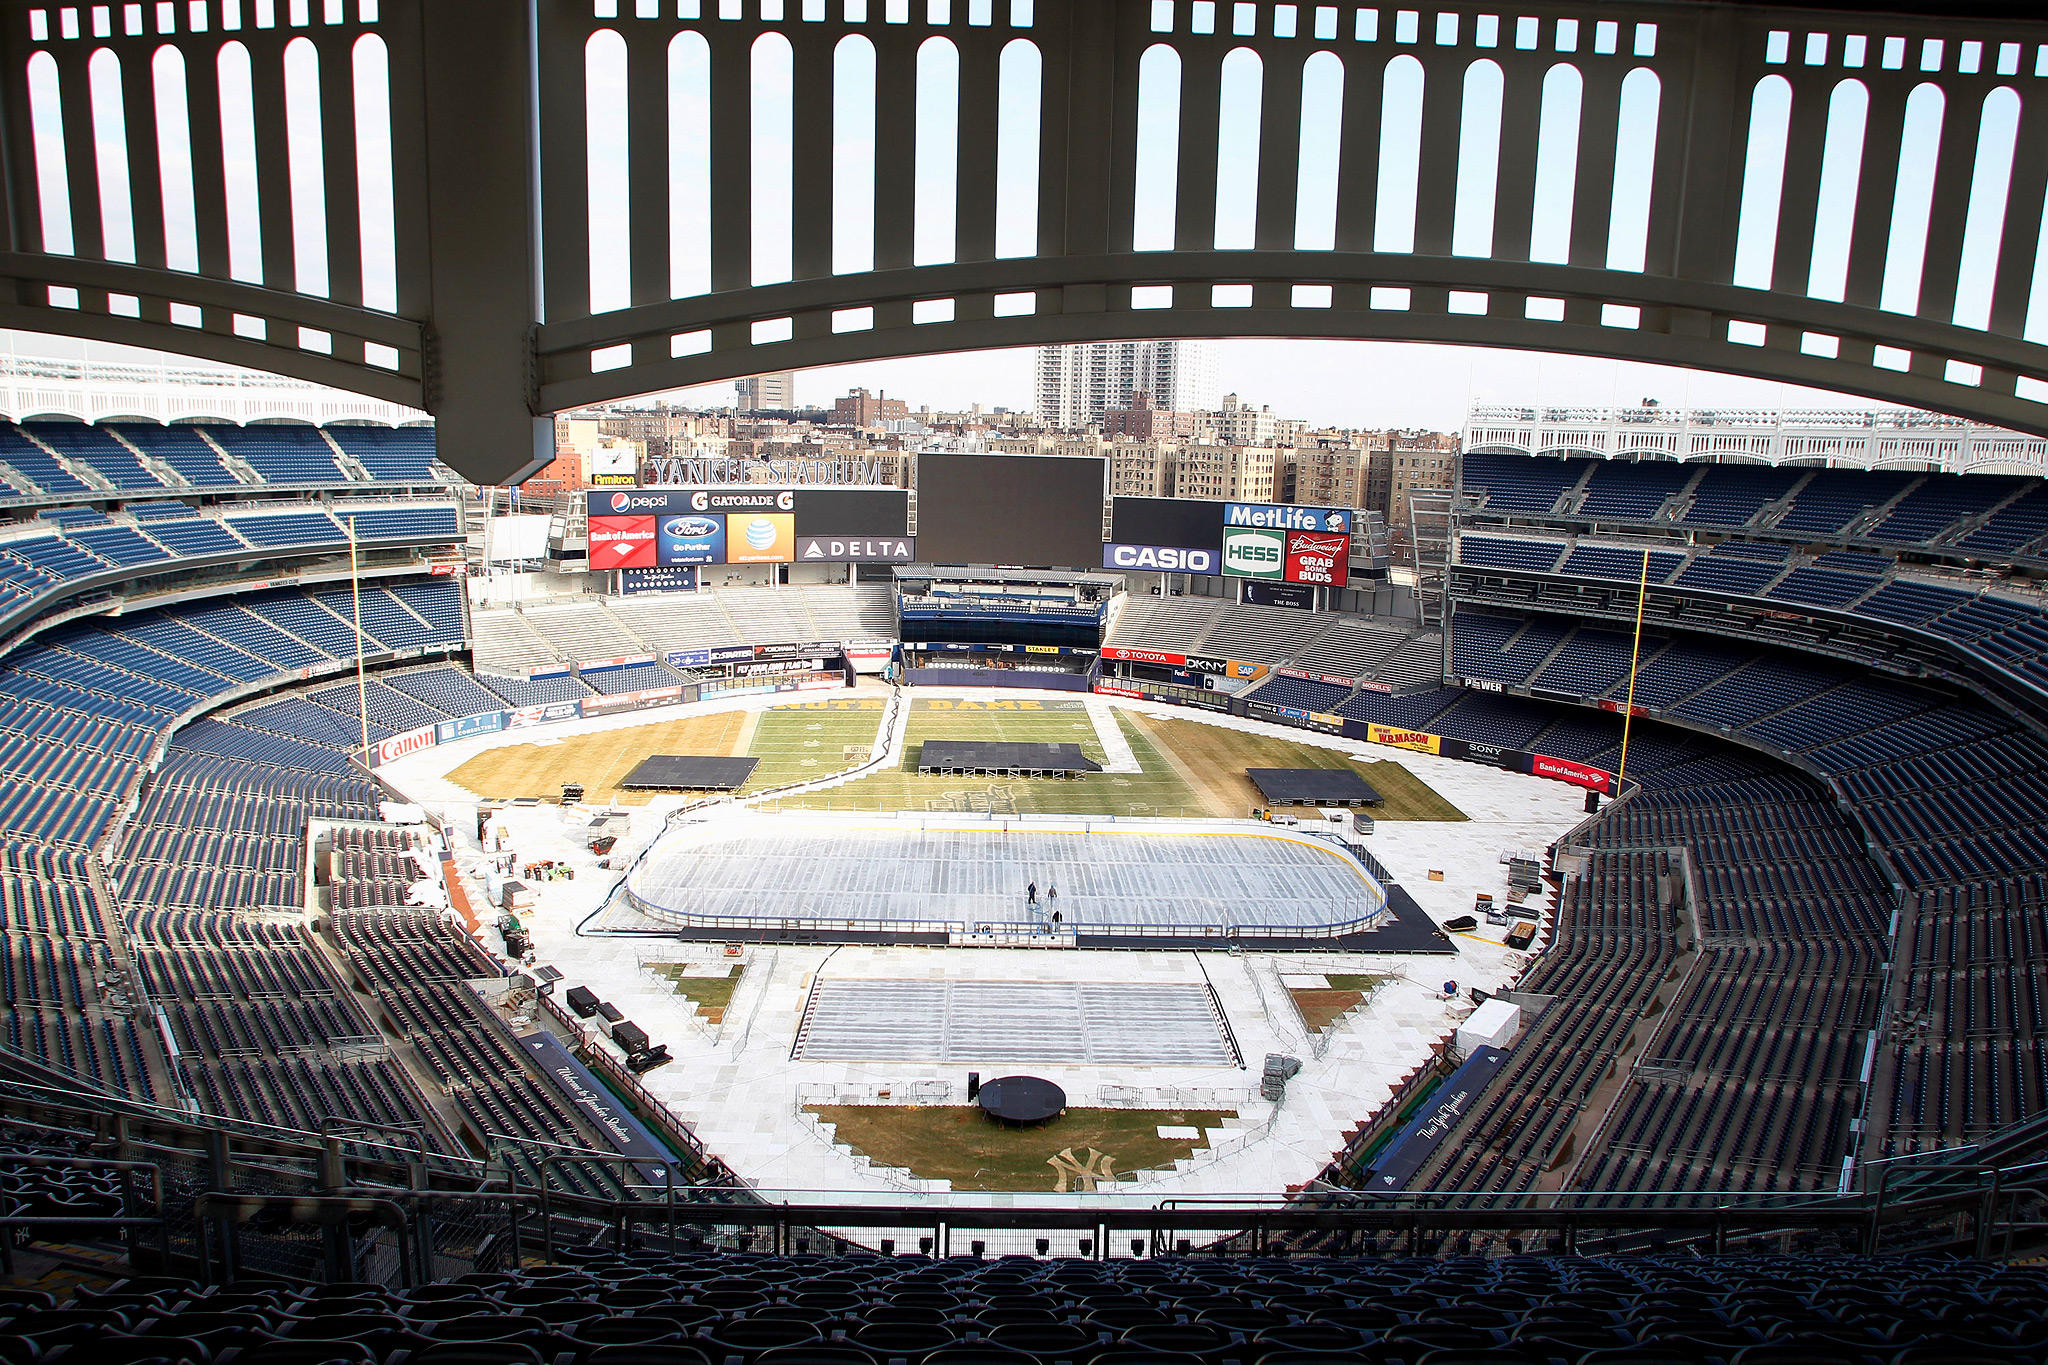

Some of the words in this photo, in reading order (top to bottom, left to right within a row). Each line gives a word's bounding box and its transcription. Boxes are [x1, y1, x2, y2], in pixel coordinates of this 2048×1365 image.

[651, 459, 754, 485] YANKEE
[768, 459, 882, 486] STADIUM
[594, 474, 635, 485] Armitron
[630, 494, 668, 509] pepsi
[711, 496, 774, 506] GATORADE
[1229, 505, 1317, 531] MetLife
[674, 521, 709, 536] Ford
[590, 532, 612, 541] Bank
[612, 531, 622, 541] of
[621, 530, 656, 540] America
[673, 544, 685, 552] Go
[685, 543, 711, 551] Further
[830, 541, 909, 557] DELTA
[1290, 538, 1343, 552] Budweiser
[1114, 545, 1211, 572] CASIO
[1228, 544, 1279, 563] HESS
[1299, 556, 1334, 568] GRAB
[1304, 565, 1328, 574] SOME
[1298, 570, 1333, 583] BUDS
[720, 650, 753, 659] STARTER
[764, 645, 797, 653] YOKOHAMA
[1131, 651, 1167, 662] TOYOTA
[737, 665, 750, 674] FLY
[750, 663, 769, 673] YOUR
[768, 662, 786, 671] OWN
[785, 660, 803, 670] FLAG
[1186, 659, 1227, 673] DKNY
[1237, 666, 1254, 675] SAP
[1174, 669, 1191, 677] FedEx
[1280, 668, 1306, 678] MODELL'S
[1322, 675, 1351, 685] MODELL'S
[1362, 682, 1392, 691] MODELL'S
[927, 700, 1044, 710] DAME
[458, 724, 497, 736] CONSULTING
[381, 730, 434, 761] Canon
[1468, 743, 1503, 756] SONY
[1539, 762, 1557, 773] Bank
[1556, 767, 1564, 775] of
[1563, 768, 1589, 781] America
[556, 1066, 583, 1091] Welcome
[575, 1094, 610, 1117] Yankee
[602, 1117, 631, 1144] Stadium
[1416, 1124, 1439, 1139] New
[1428, 1109, 1450, 1130] York
[1439, 1090, 1468, 1116] Yankees
